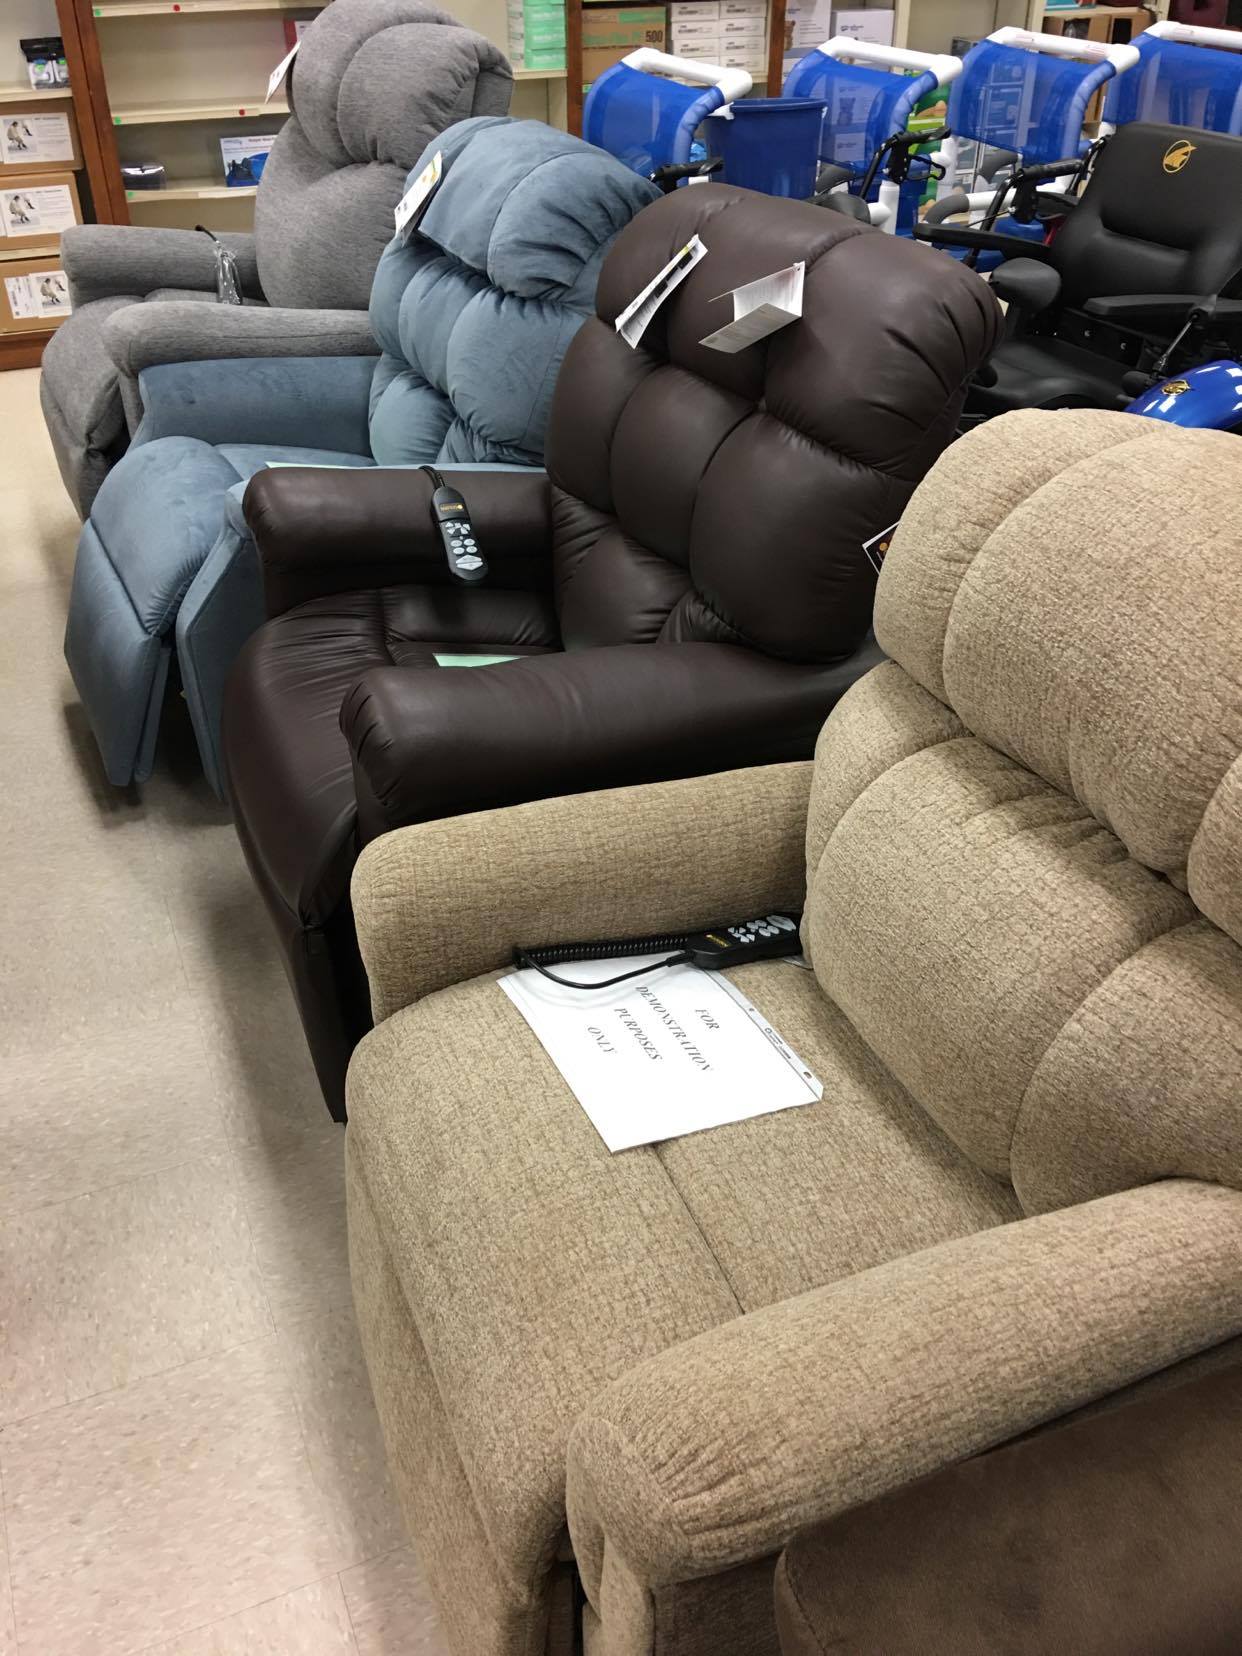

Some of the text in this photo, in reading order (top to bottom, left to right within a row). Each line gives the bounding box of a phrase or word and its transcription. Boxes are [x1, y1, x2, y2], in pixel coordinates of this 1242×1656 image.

[645, 30, 663, 43] 500
[614, 1008, 663, 1061] PURPOSES
[635, 986, 714, 1072] DEMONSTRATION
[695, 1008, 720, 1031] FOR
[587, 1026, 618, 1056] ONLY
